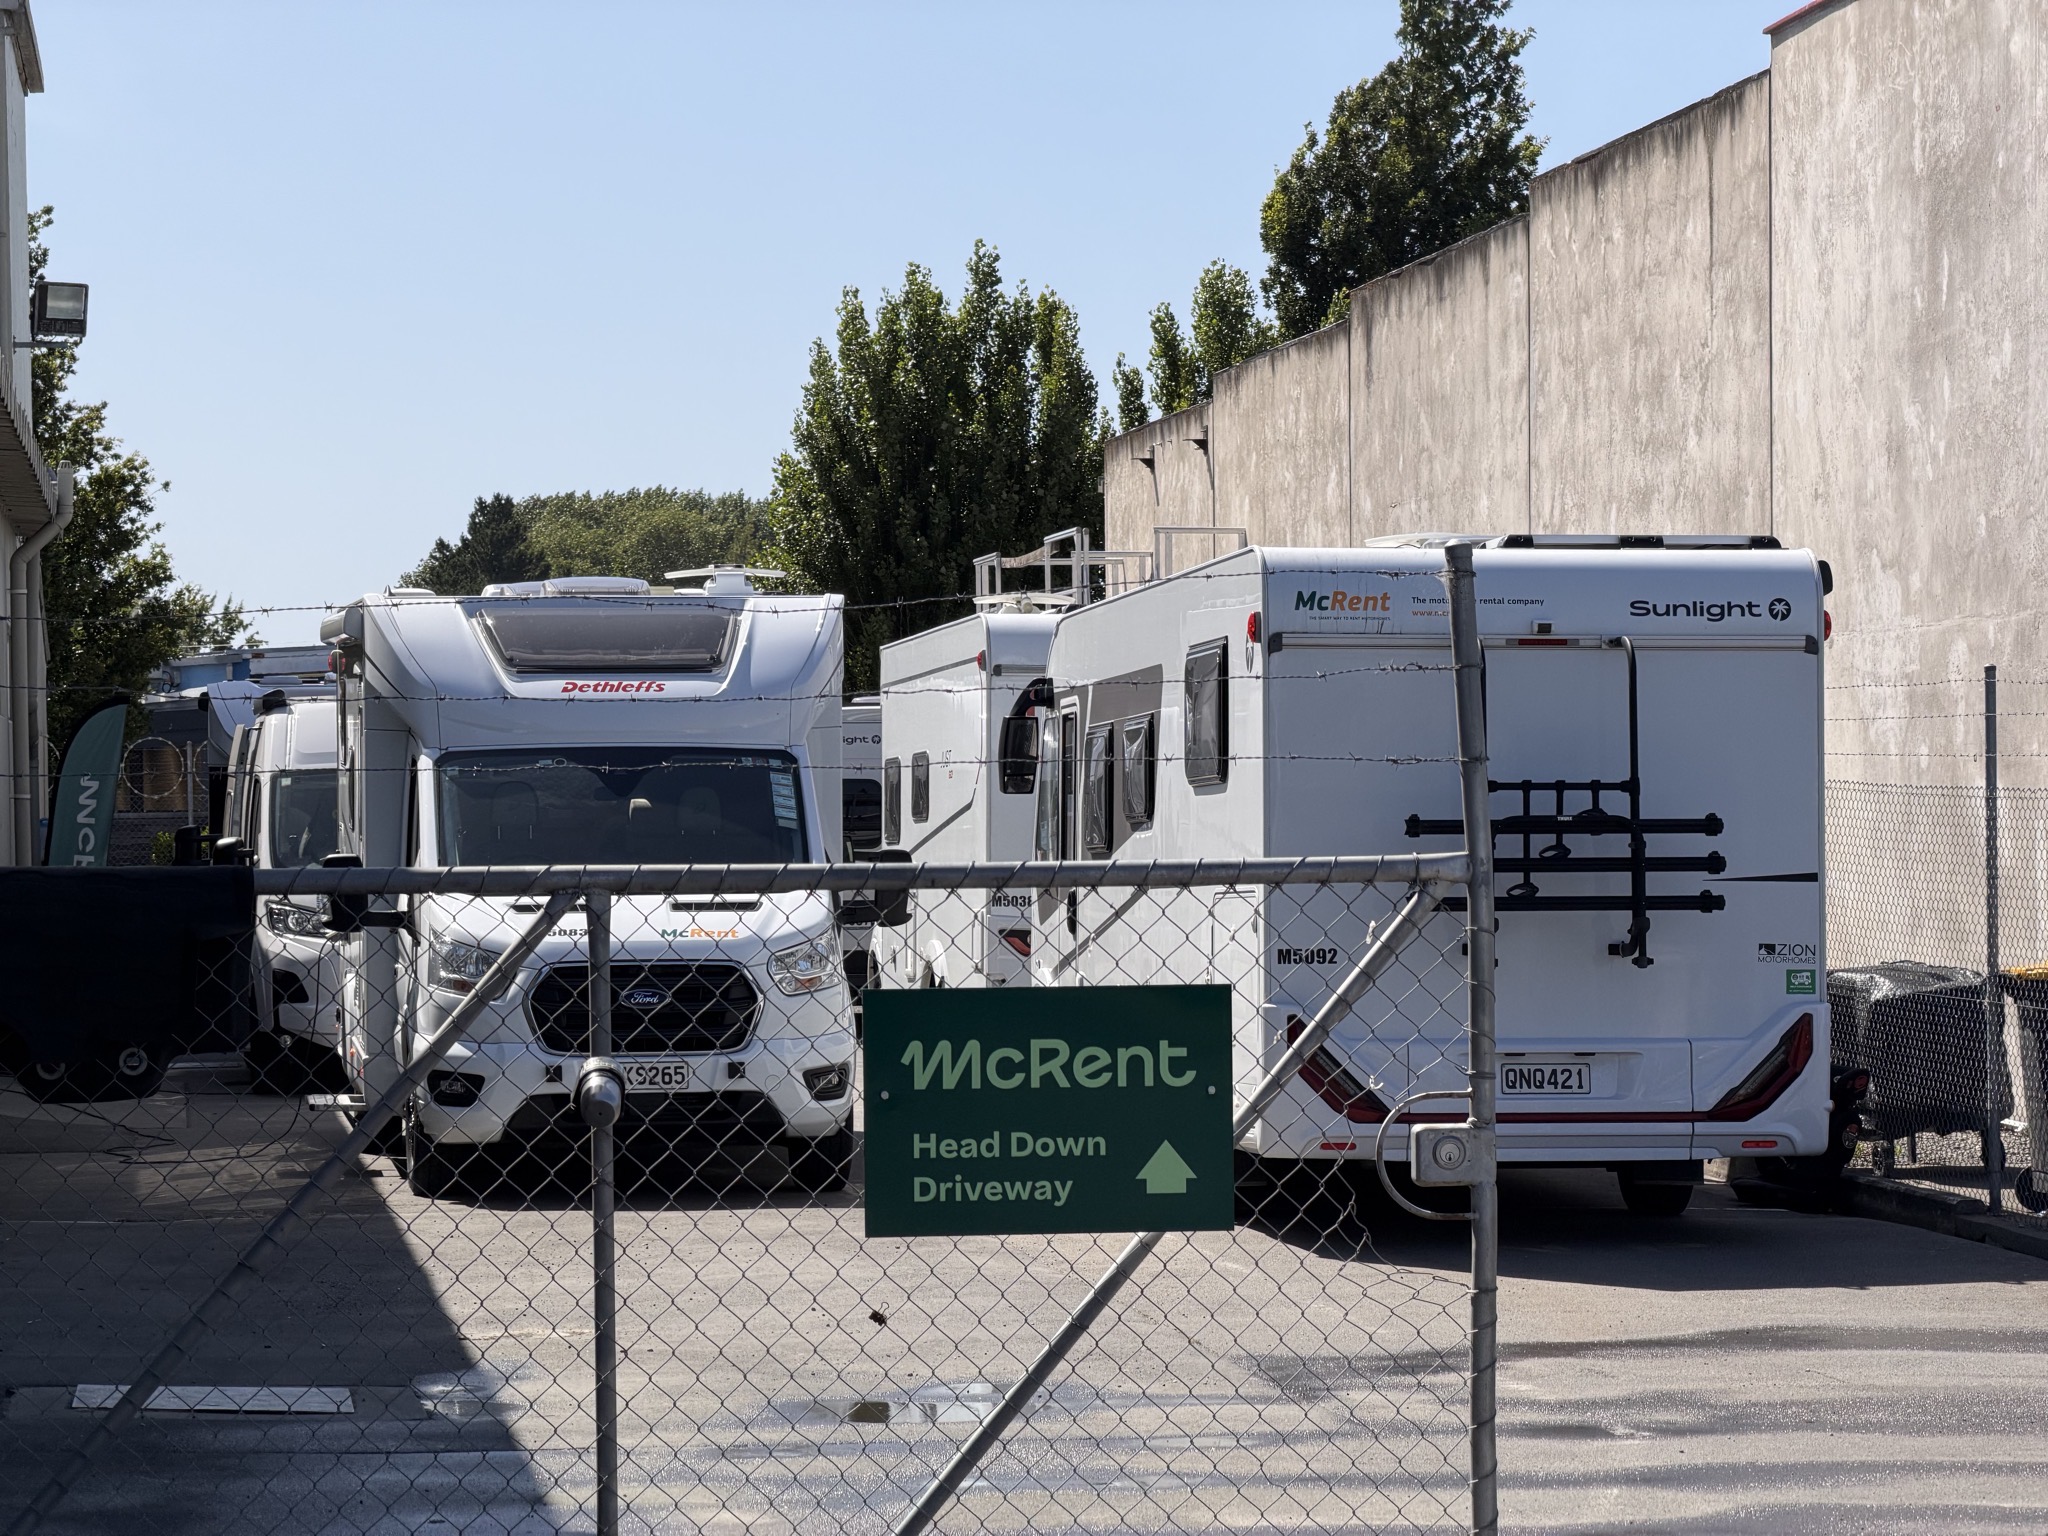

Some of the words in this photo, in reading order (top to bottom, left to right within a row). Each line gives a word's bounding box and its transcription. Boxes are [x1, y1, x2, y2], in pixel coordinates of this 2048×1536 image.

[1294, 590, 1391, 611] McRent
[1411, 596, 1426, 604] The
[1479, 597, 1505, 605] rental
[1507, 598, 1545, 606] company
[1629, 600, 1762, 622] Sunlight
[560, 681, 666, 693] Dethleffs
[842, 735, 870, 746] ight
[547, 928, 589, 938] 5083
[660, 928, 739, 938] McRent
[1277, 948, 1338, 965] M5092
[1777, 943, 1816, 956] ZION
[1757, 955, 1816, 965] MOTORHOMES
[630, 991, 660, 1004] Ford
[900, 1038, 1197, 1091] McRent
[623, 1065, 686, 1087] KS265
[1505, 1068, 1584, 1090] QNQ421
[913, 1131, 1000, 1159] Head
[1010, 1131, 1107, 1158] Down
[913, 1174, 1073, 1207] Driveway
